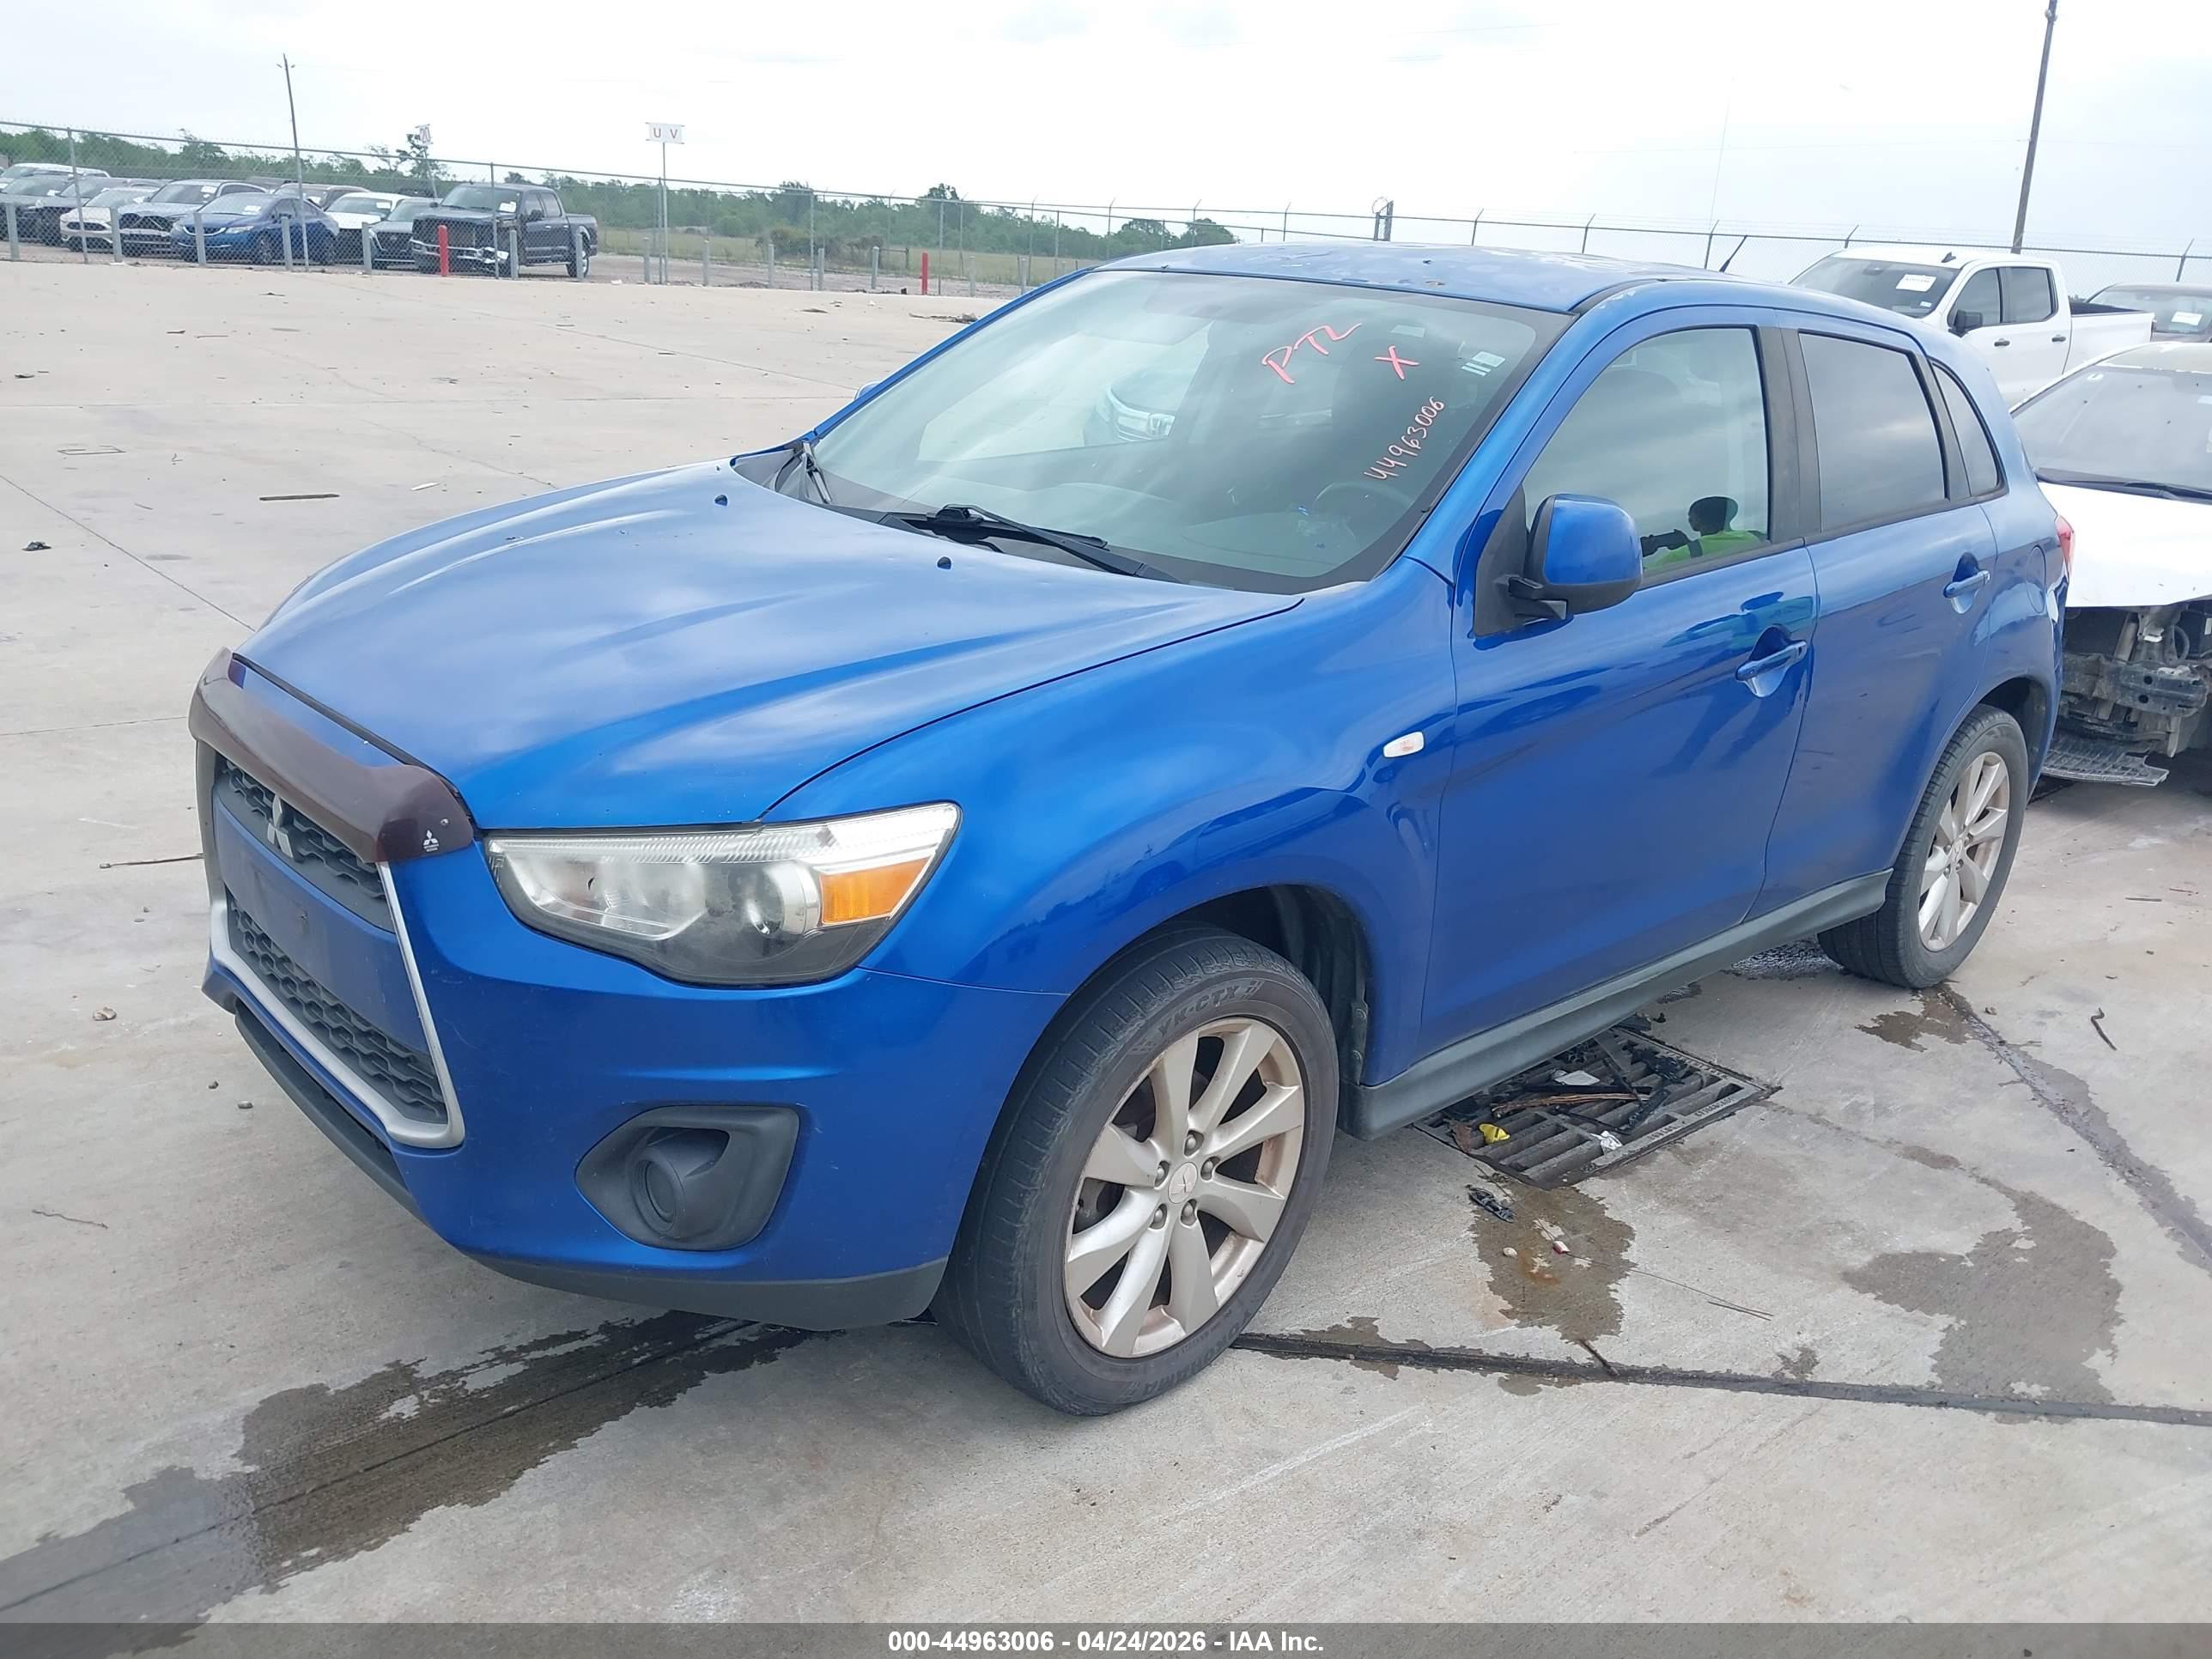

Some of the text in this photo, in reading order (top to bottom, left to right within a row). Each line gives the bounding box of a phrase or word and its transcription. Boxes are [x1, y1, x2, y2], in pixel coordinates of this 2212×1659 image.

[653, 127, 678, 139] U V
[1364, 396, 1445, 480] 44963006
